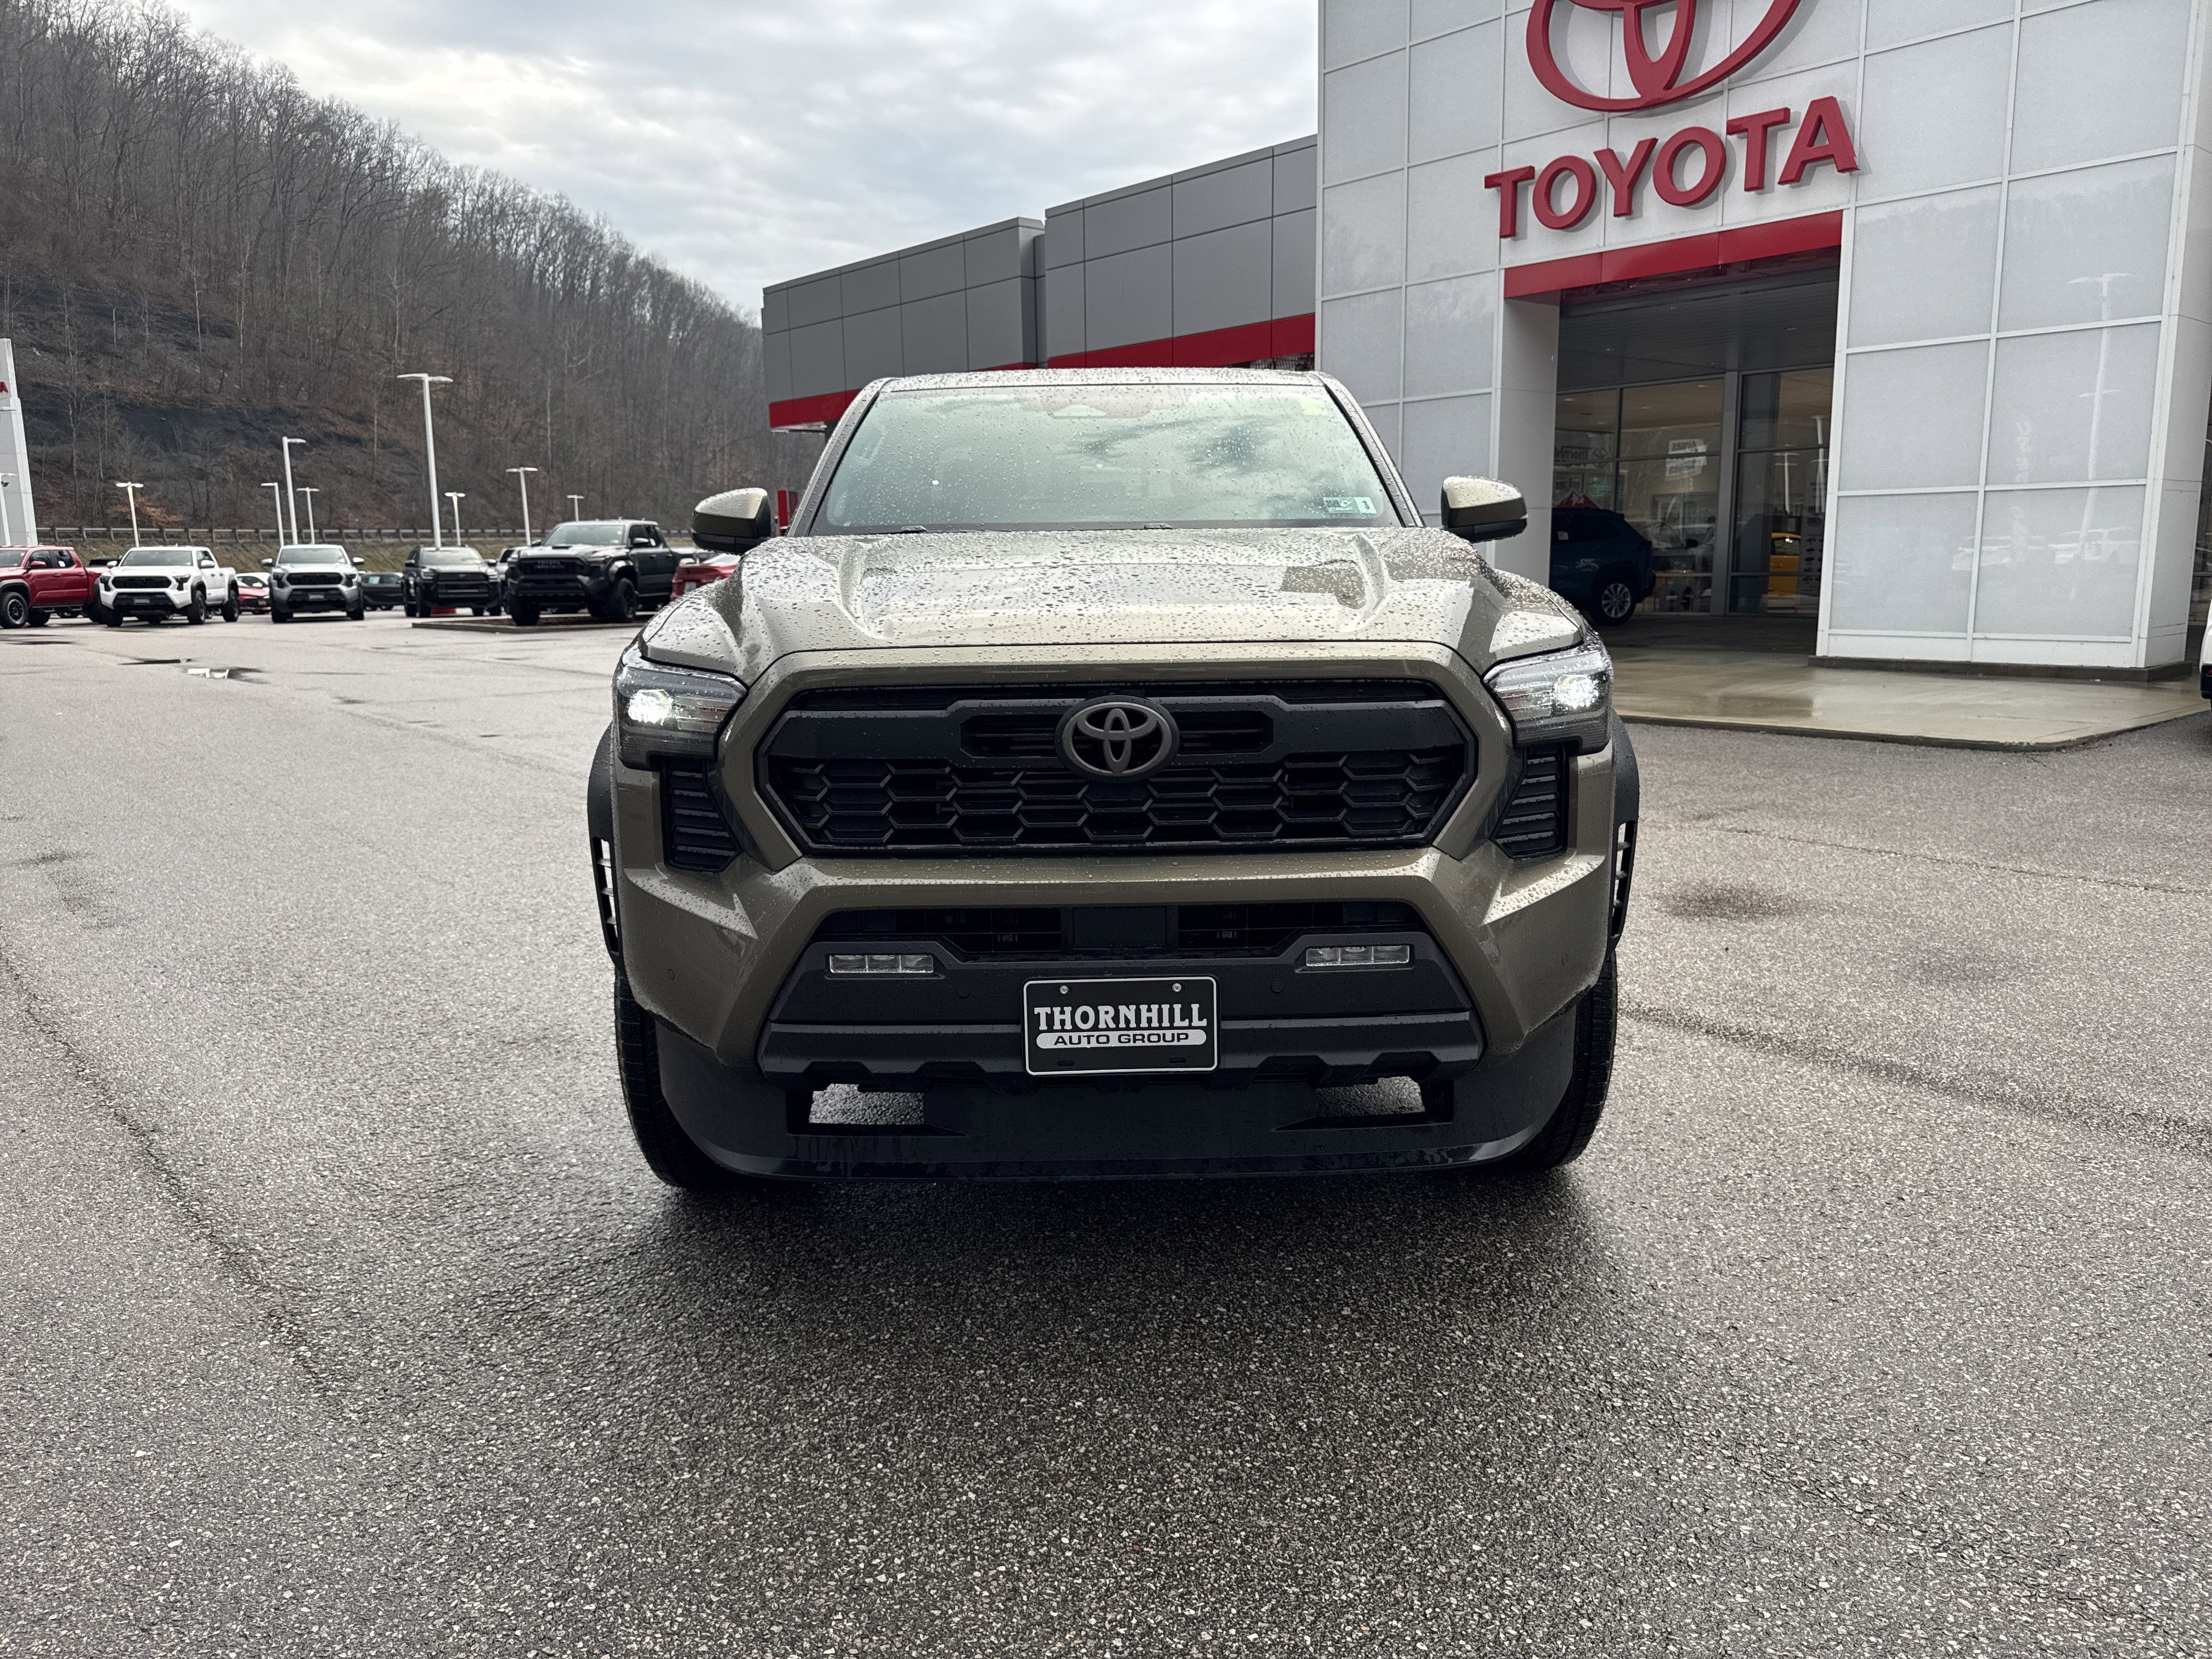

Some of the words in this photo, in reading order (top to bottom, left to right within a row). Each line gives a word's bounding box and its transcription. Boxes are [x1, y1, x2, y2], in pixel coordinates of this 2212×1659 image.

[1484, 95, 1859, 238] TOYOTA
[1362, 500, 1370, 510] 3
[1034, 1003, 1207, 1030] THORNHILL
[1054, 1034, 1110, 1046] AUTO
[1118, 1032, 1189, 1044] GROUP
